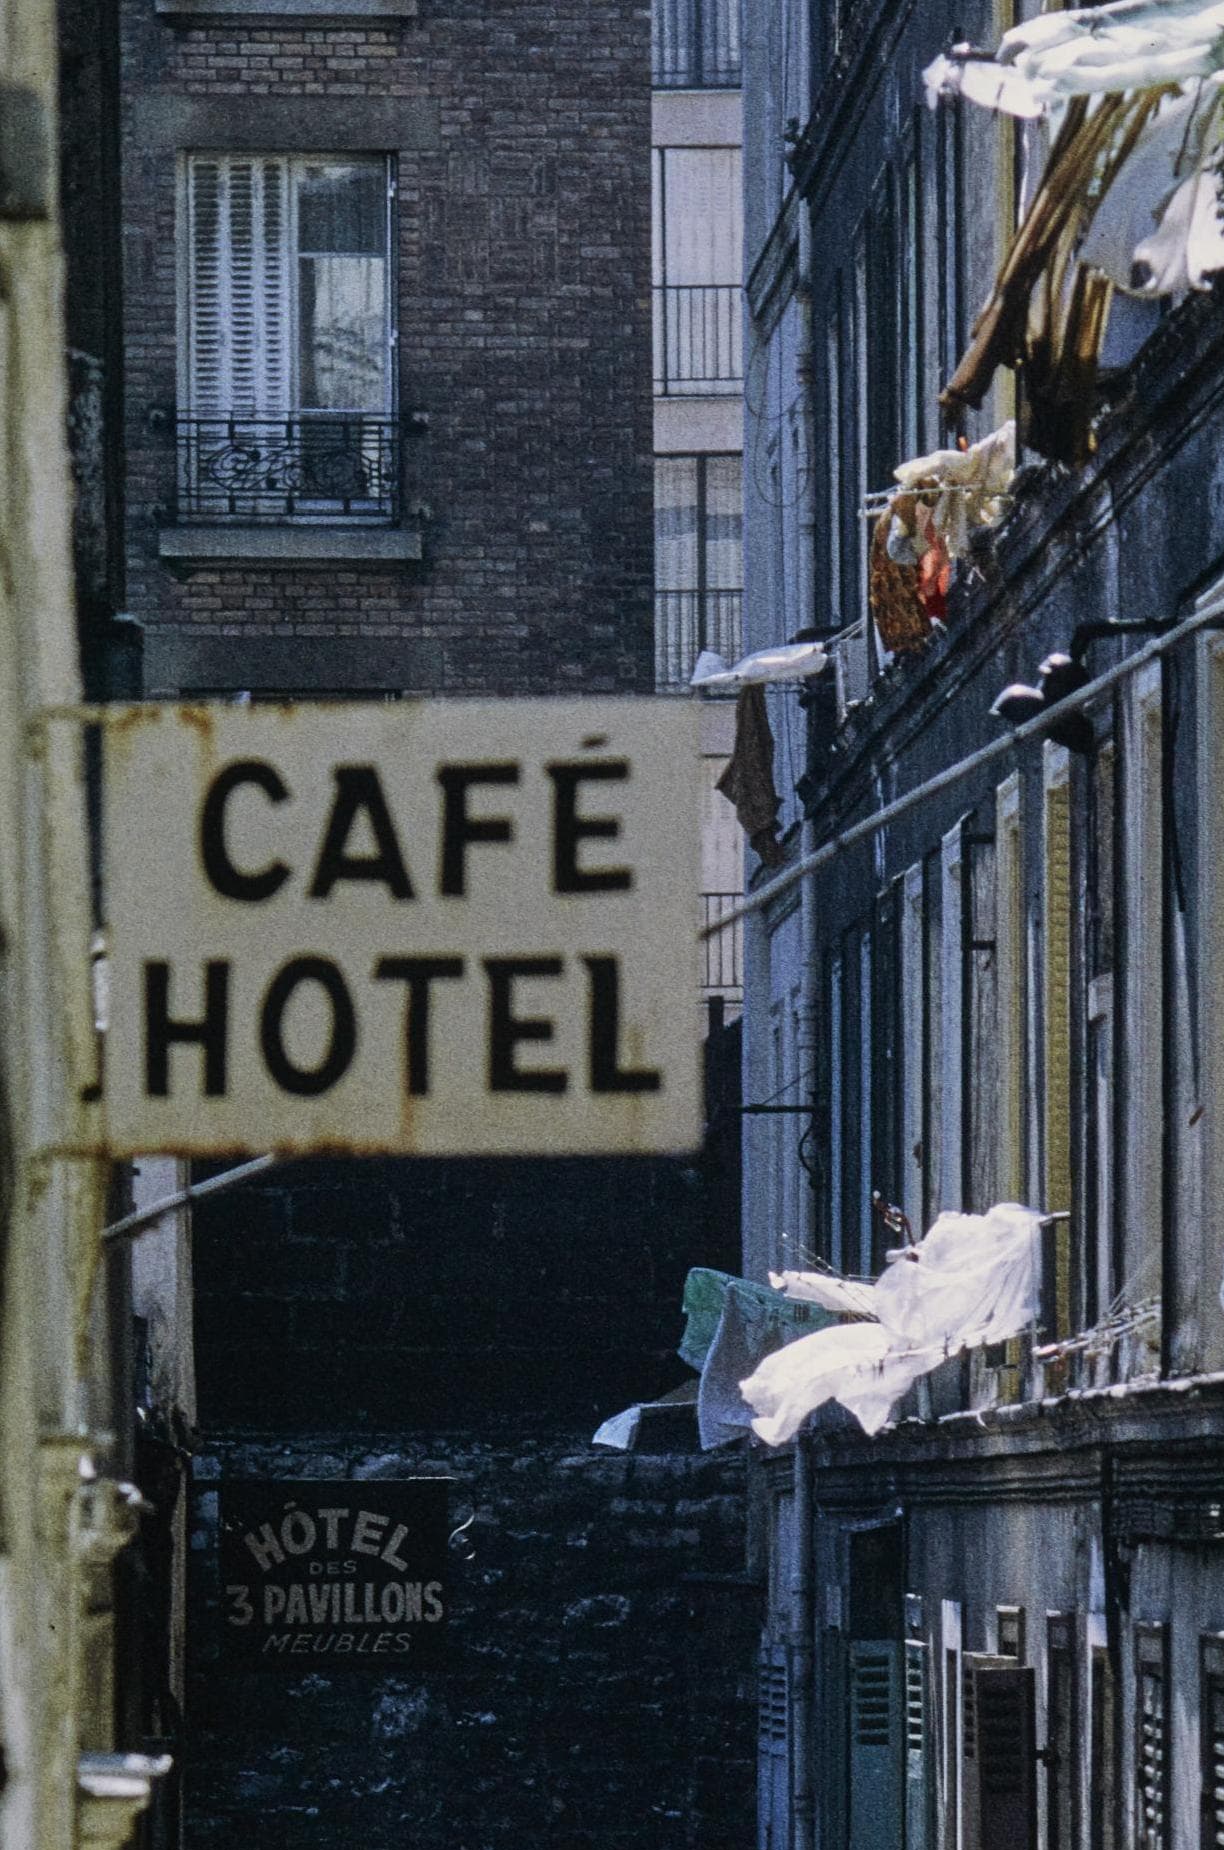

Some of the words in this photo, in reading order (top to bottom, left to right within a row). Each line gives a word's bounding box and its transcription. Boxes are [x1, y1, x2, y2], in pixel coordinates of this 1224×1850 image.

[196, 737, 635, 905] CAFÉ
[142, 953, 664, 1101] HOTEL
[309, 1560, 357, 1574] DES
[226, 1585, 254, 1626] 3
[264, 1581, 443, 1624] PAVILLONS
[262, 1633, 411, 1653] MEUBLES
